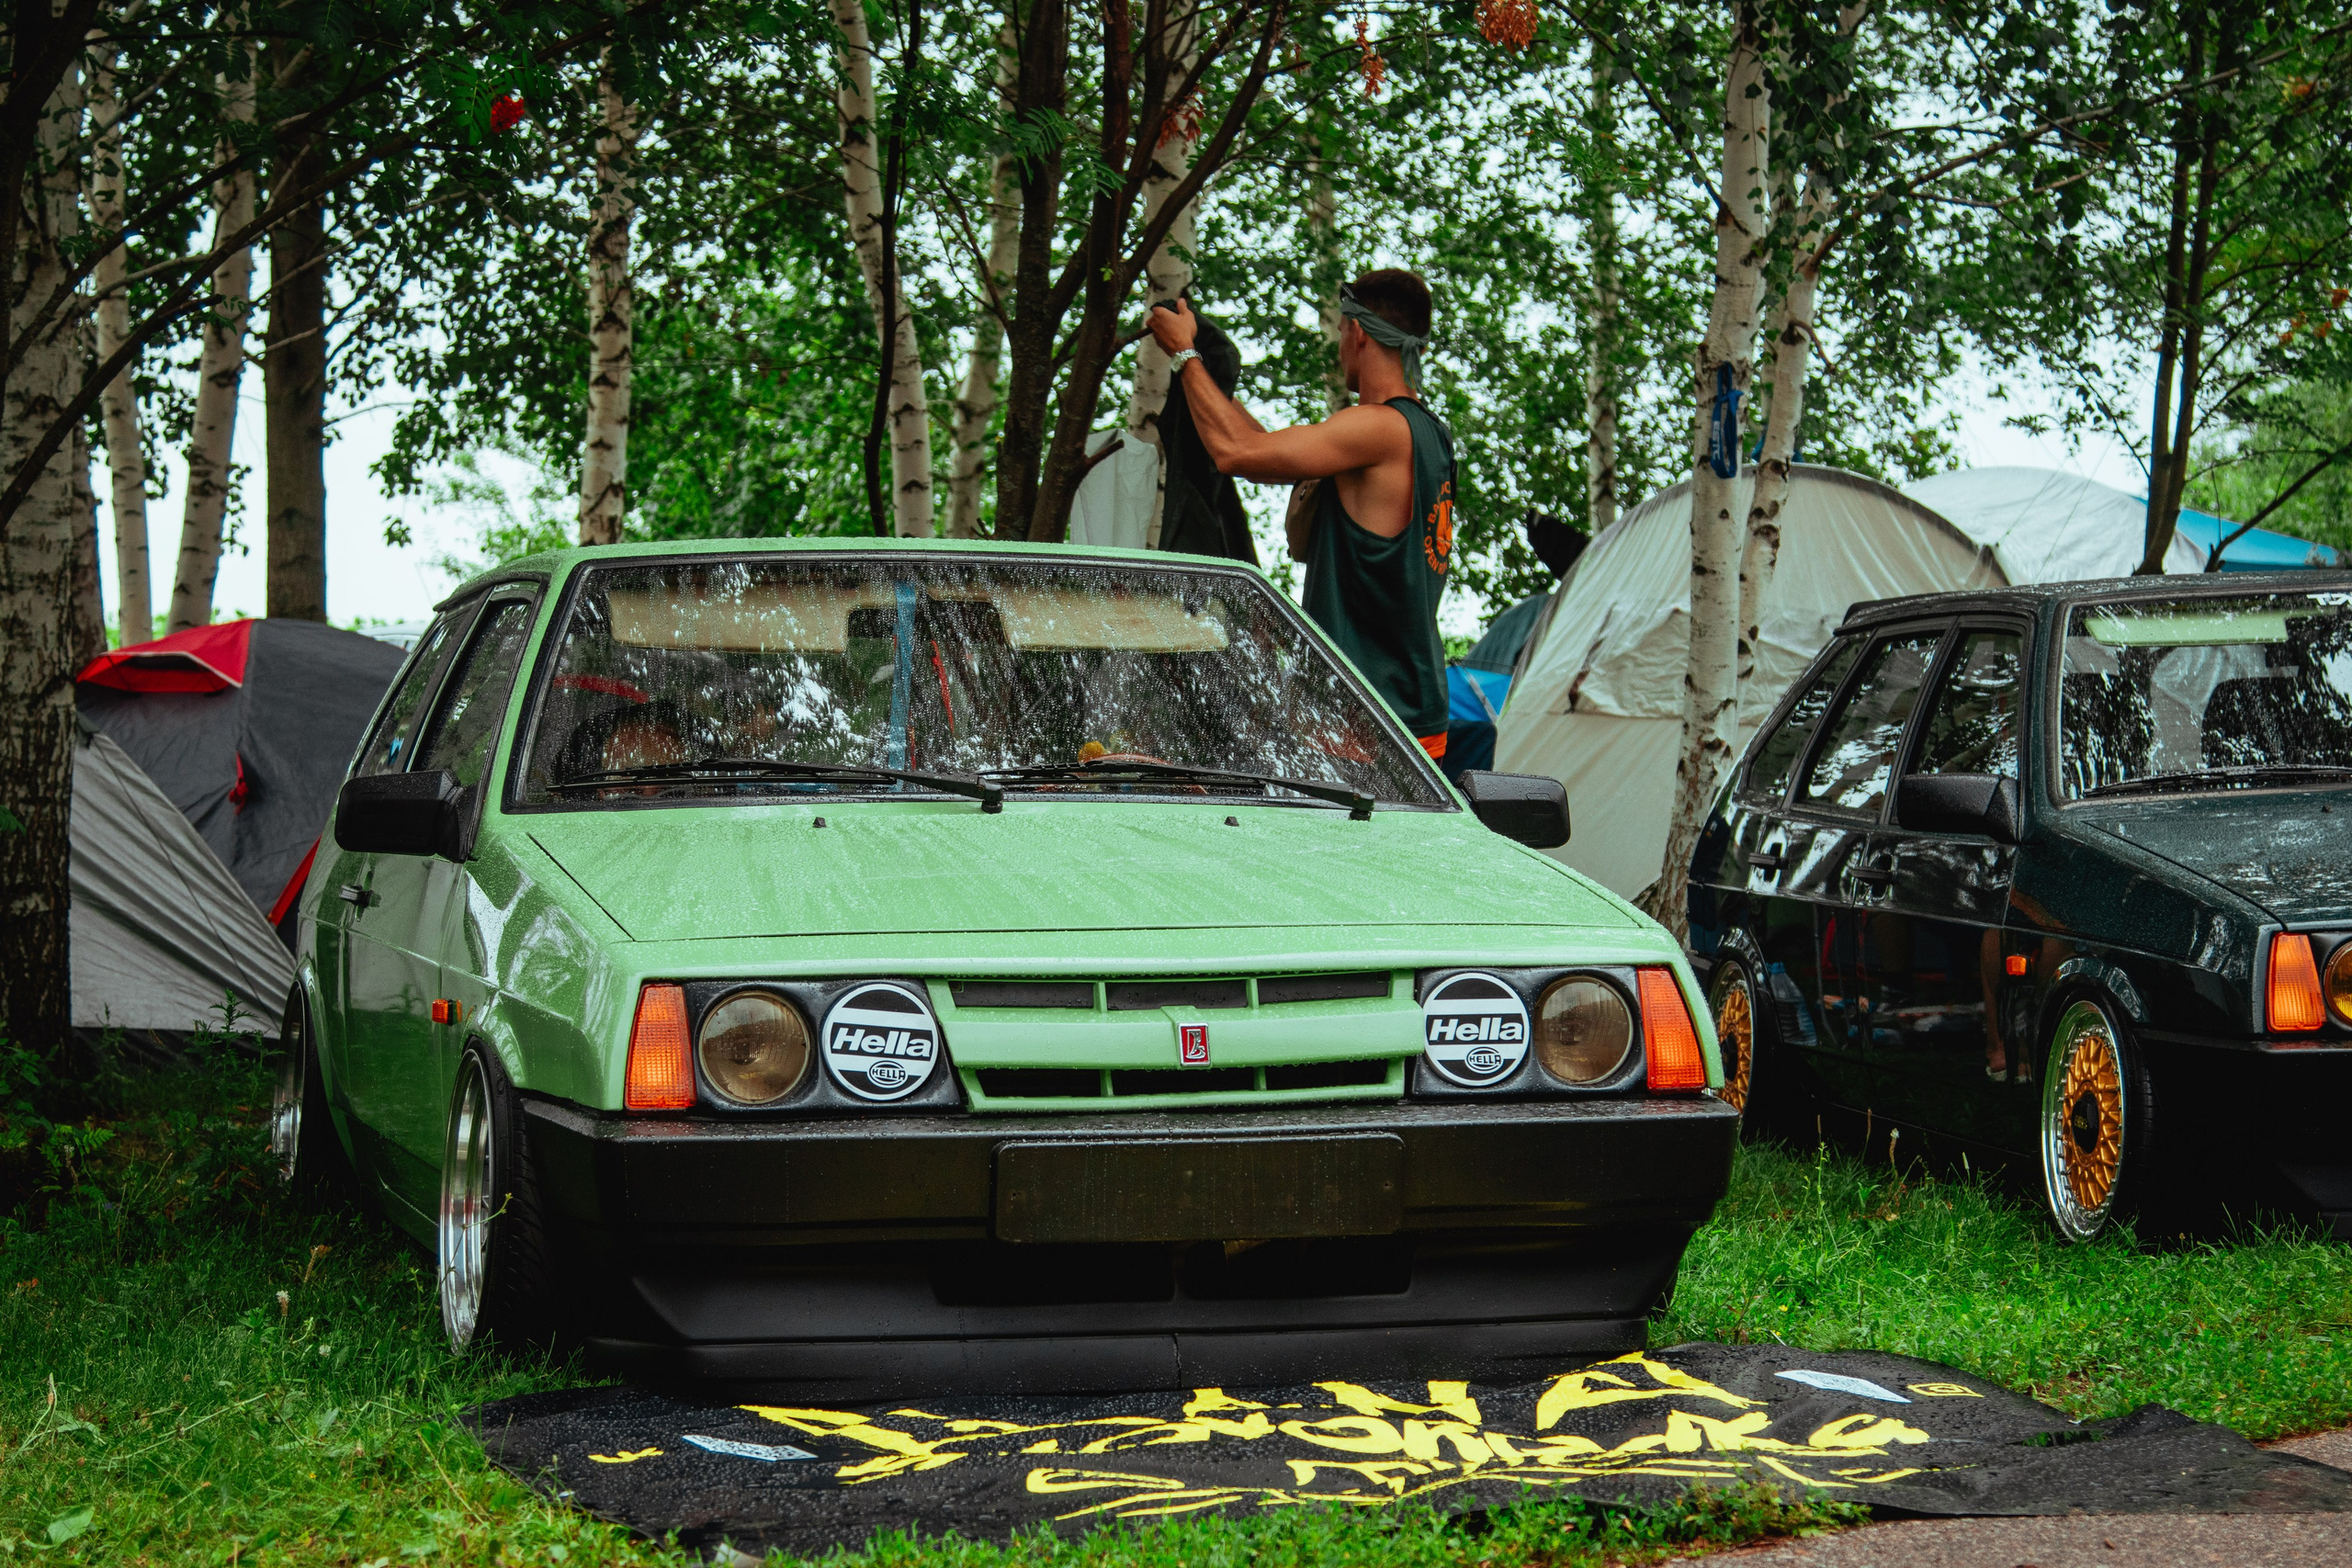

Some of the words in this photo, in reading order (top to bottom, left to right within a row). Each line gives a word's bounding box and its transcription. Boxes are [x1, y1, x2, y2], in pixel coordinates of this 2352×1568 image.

[1430, 1017, 1523, 1041] Hella
[831, 1027, 932, 1057] Hella
[1469, 1055, 1501, 1066] HELLA
[872, 1068, 905, 1081] HELLA
